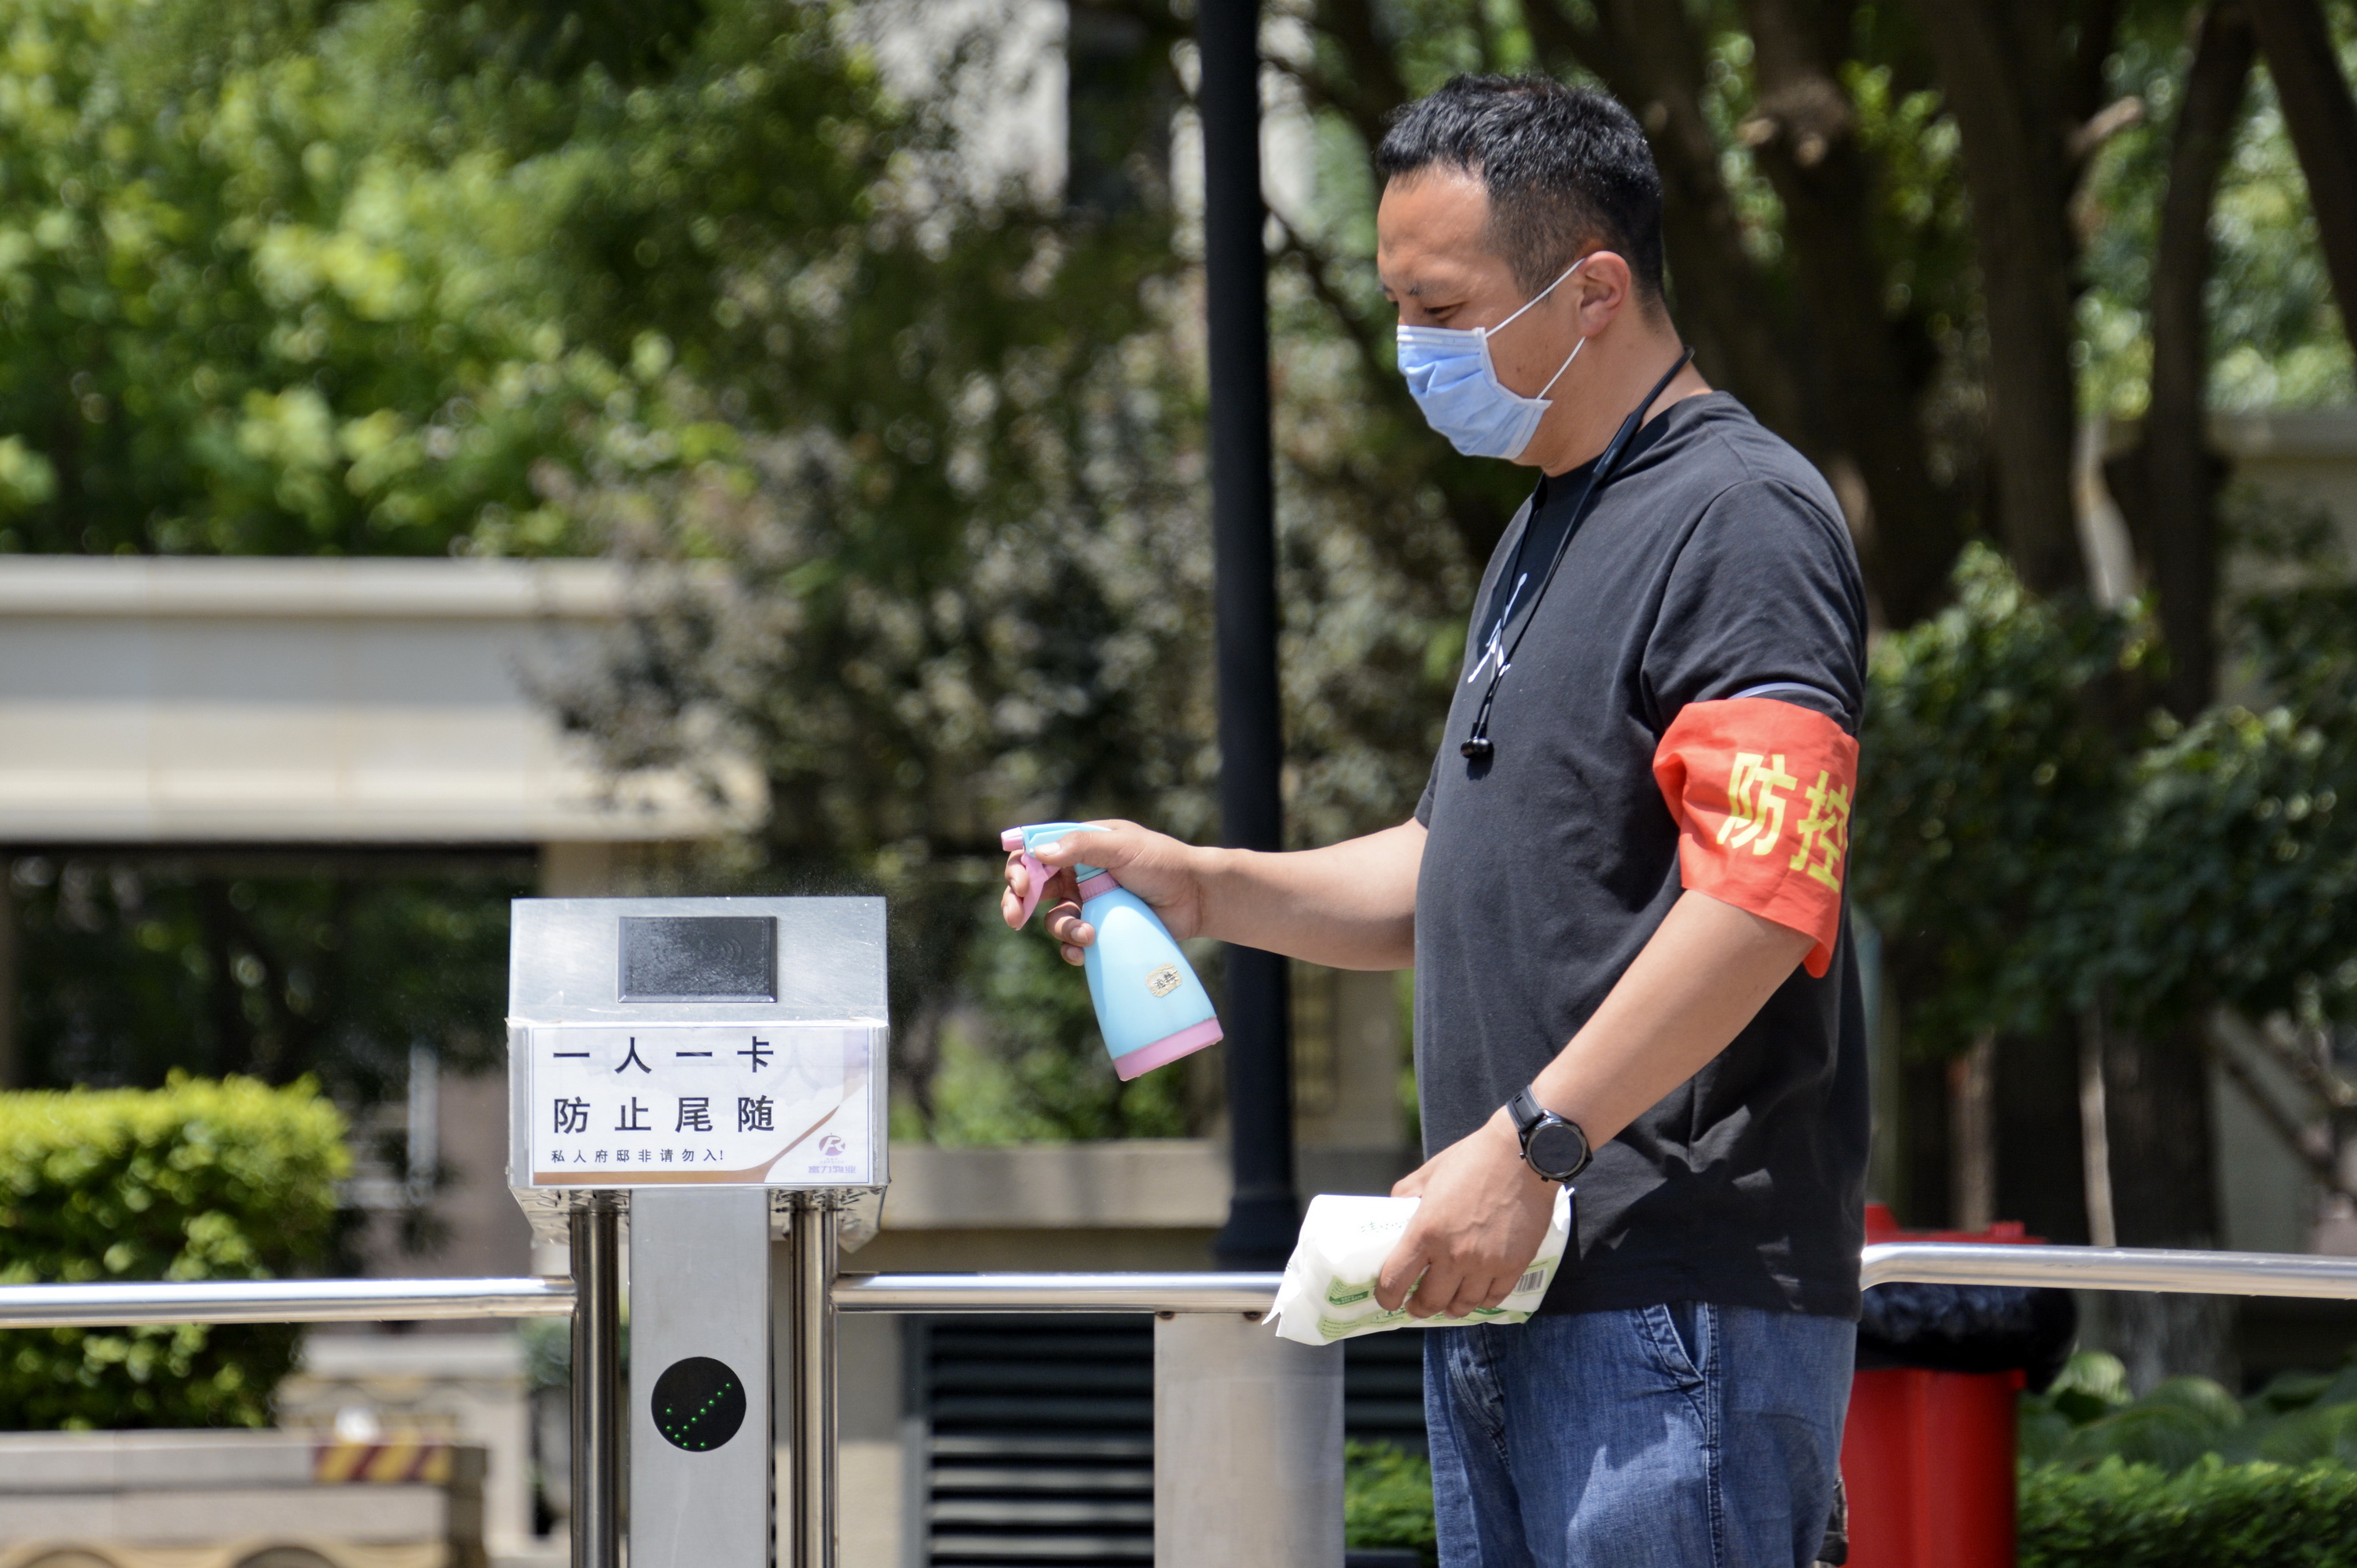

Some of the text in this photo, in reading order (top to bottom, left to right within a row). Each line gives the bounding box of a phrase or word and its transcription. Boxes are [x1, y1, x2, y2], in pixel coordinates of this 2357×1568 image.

[1717, 753, 1849, 893] 防控
[552, 1035, 774, 1075] 一人一卡
[553, 1095, 775, 1135] 防止尾随
[551, 1149, 724, 1163] 私人府邸非请勿入!
